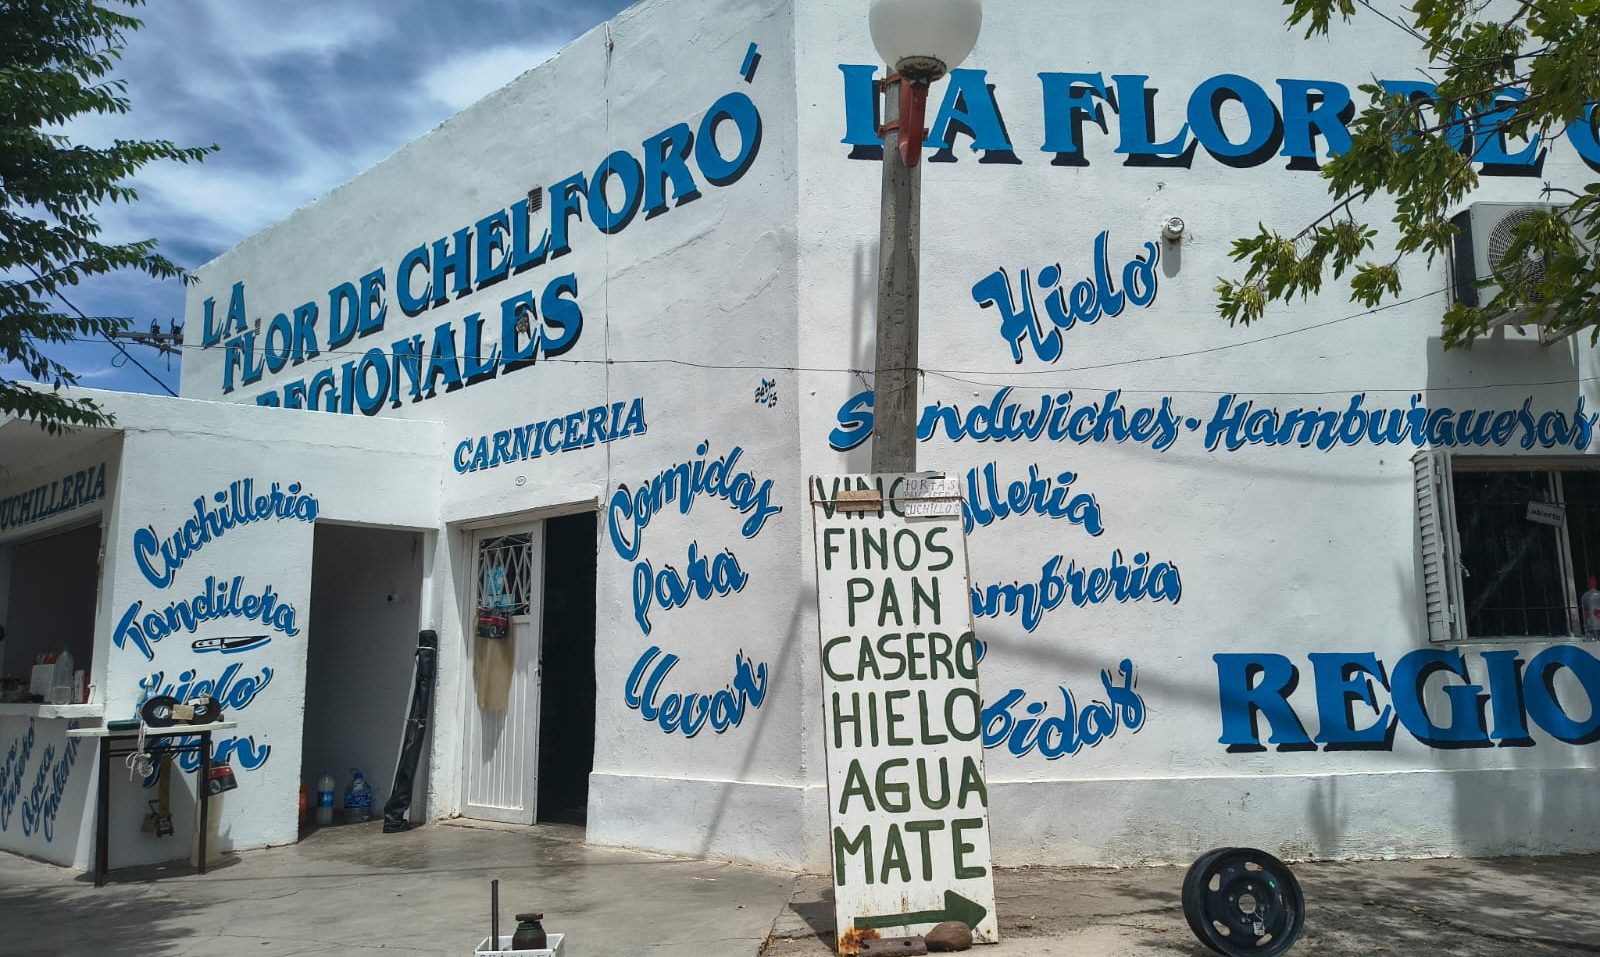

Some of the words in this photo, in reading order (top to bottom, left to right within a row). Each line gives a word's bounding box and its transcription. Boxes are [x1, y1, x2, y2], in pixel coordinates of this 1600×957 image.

[1038, 72, 1357, 171] FLOR
[396, 42, 762, 317] CHELFORÓ
[203, 281, 249, 350] LA
[328, 267, 387, 353] DE
[972, 230, 1160, 364] Hielo
[223, 300, 321, 394] FLOR
[256, 272, 583, 417] GIONALES
[453, 398, 647, 475] CARNICERIA
[828, 386, 1177, 452] Sndwiches
[0, 462, 106, 530] UCHILLERIA
[134, 478, 320, 590] Cuchilleria
[608, 440, 783, 562] Comidas
[960, 460, 1103, 537] lleria
[824, 526, 954, 571] FINOS
[113, 575, 300, 662] Tandilera
[847, 576, 941, 627] PAN
[969, 549, 1182, 633] mbreria
[822, 632, 979, 681] CASERO
[833, 688, 982, 748] HIELO
[980, 658, 1146, 761] bidas
[1213, 645, 1600, 753] REGIO
[838, 756, 988, 814] AGUA
[833, 818, 987, 886] MATE
